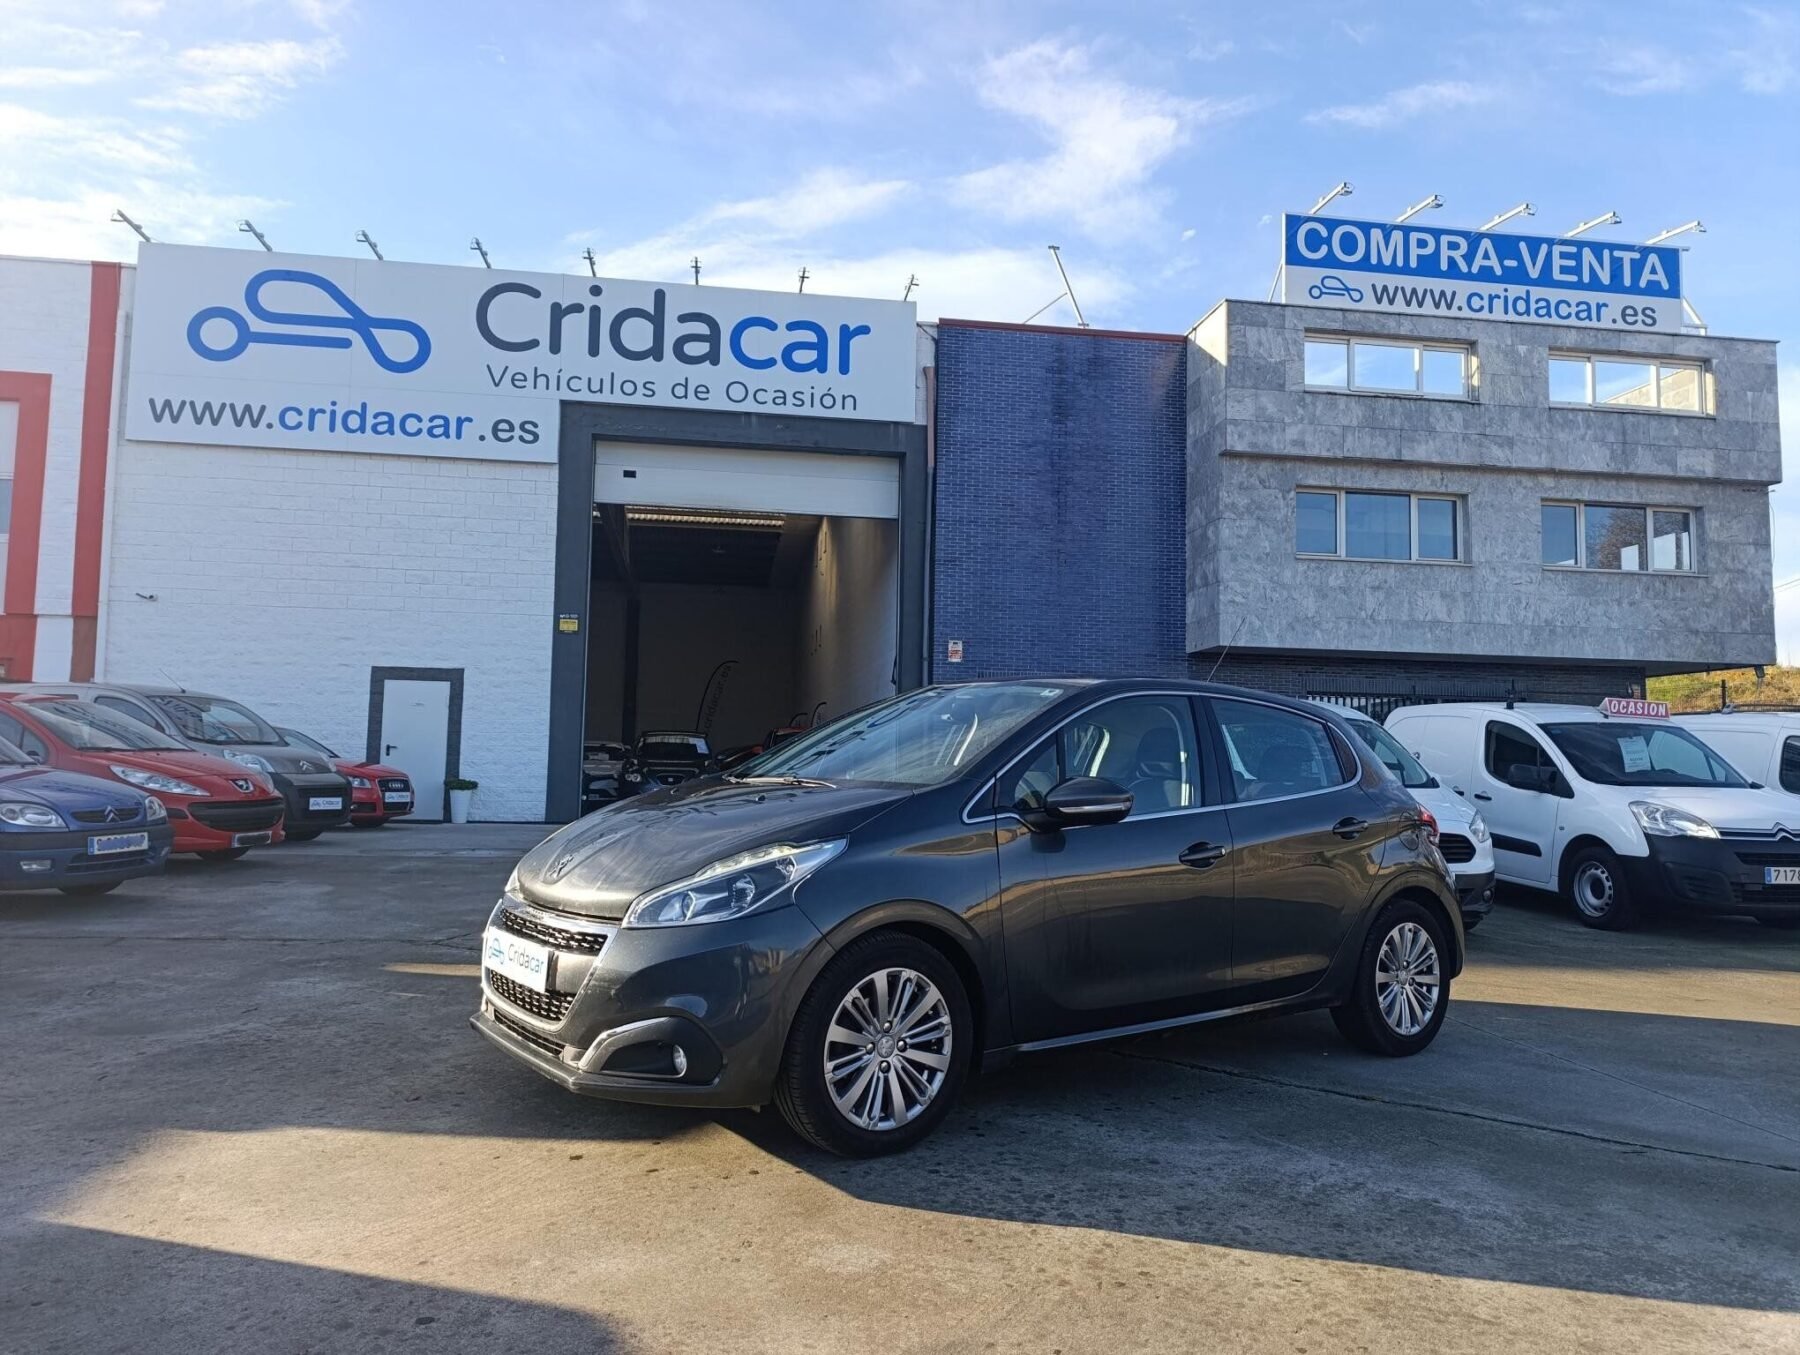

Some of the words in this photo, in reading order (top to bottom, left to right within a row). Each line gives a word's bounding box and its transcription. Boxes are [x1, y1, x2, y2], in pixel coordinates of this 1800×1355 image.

[1296, 221, 1669, 291] COMPRA-VENTA
[475, 281, 872, 376] Cridacar
[1371, 282, 1658, 328] www.cridacar.es
[486, 363, 656, 398] Vehículos
[670, 377, 711, 402] de
[725, 381, 858, 412] Ocasión
[1610, 700, 1666, 716] OCASION
